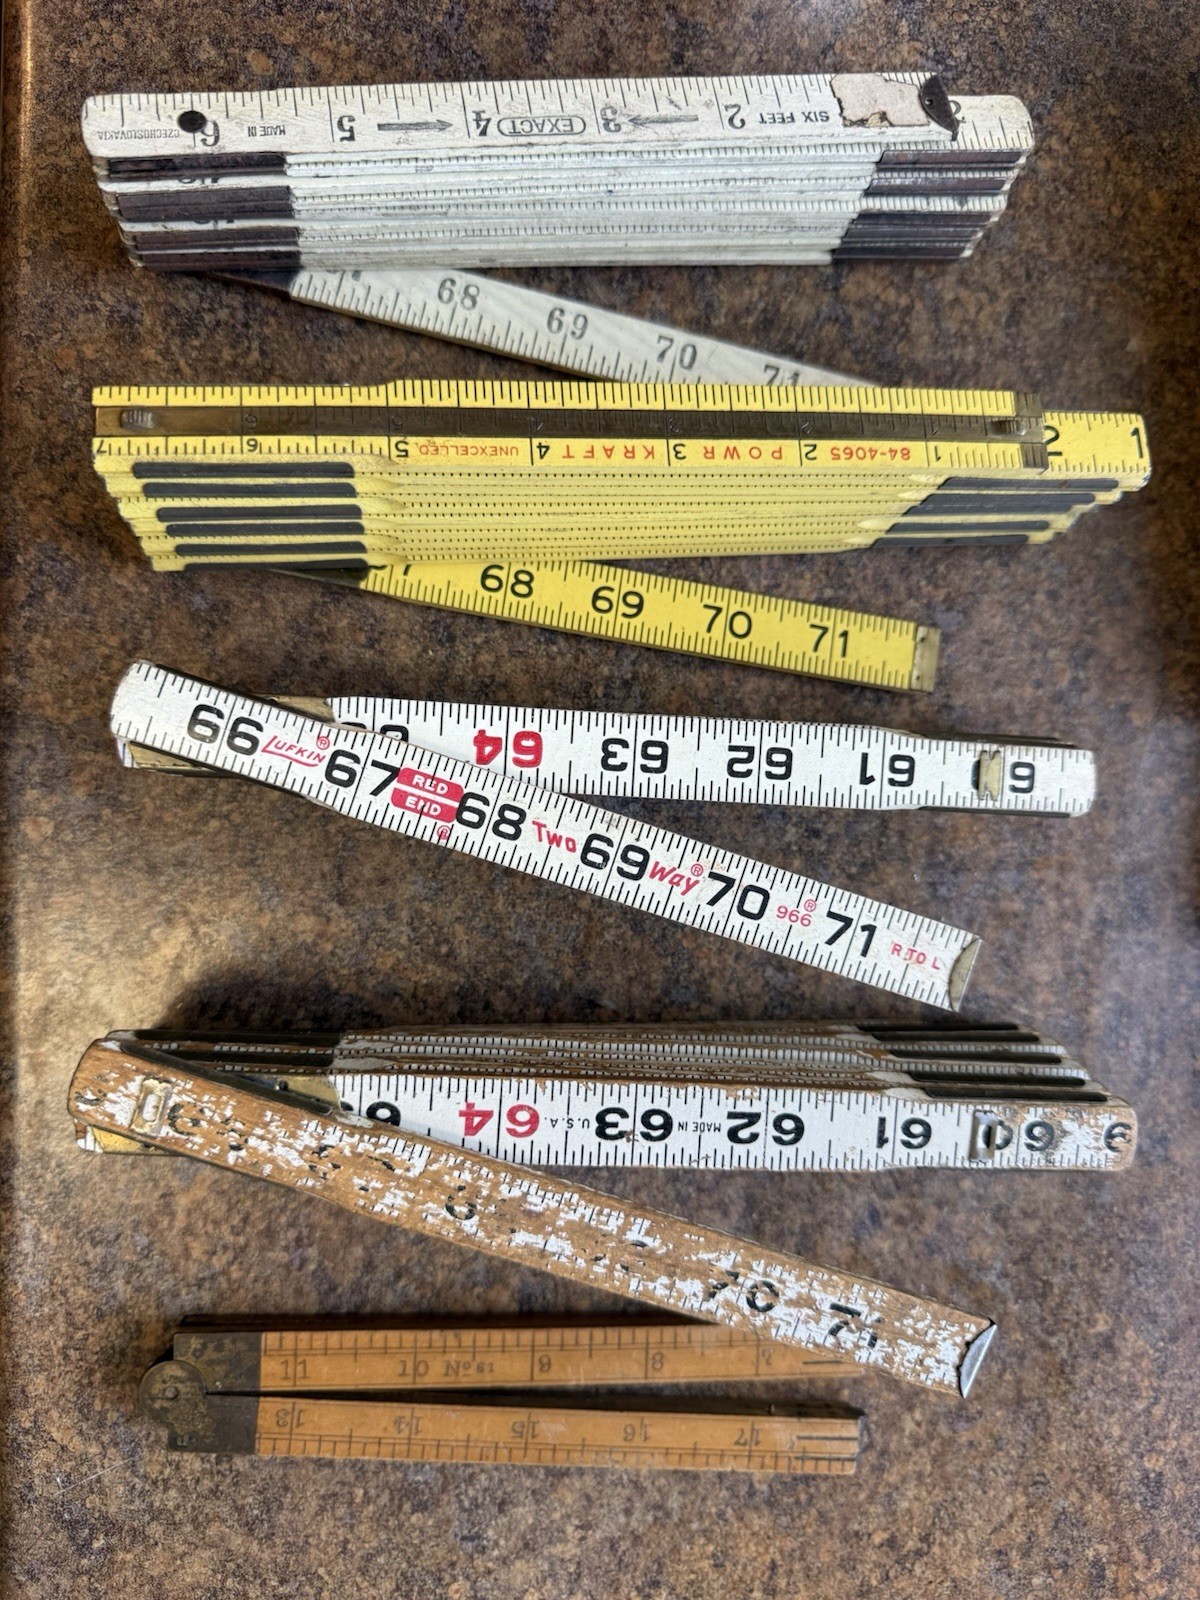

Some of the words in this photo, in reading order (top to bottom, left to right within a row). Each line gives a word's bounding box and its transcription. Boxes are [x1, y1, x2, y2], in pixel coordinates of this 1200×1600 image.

[337, 115, 356, 142] 5
[472, 110, 491, 137] 4
[508, 118, 574, 135] EXACT
[599, 106, 622, 133] 3
[724, 104, 746, 130] 2
[759, 112, 795, 125] FEET
[802, 111, 830, 123] SIX
[97, 128, 180, 141] CZECHOSLOVAKIA
[247, 126, 258, 138] IN
[259, 125, 287, 137] MADE
[437, 277, 481, 311] 68
[546, 307, 589, 340] 69
[656, 335, 698, 371] 70
[246, 438, 258, 453] 6
[395, 440, 409, 458] 5
[536, 442, 550, 460] 4
[562, 444, 655, 460] KRAFT
[672, 443, 687, 460] 3
[703, 445, 783, 461] POWR
[803, 444, 818, 461] 2
[830, 446, 911, 461] 84-4065
[934, 445, 942, 462] 1
[480, 564, 535, 599] 68
[591, 586, 645, 619] 69
[702, 604, 752, 639] 70
[809, 624, 849, 658] 71
[187, 703, 264, 756] 66
[473, 729, 544, 768] 64
[600, 738, 669, 774] 63
[726, 744, 793, 780] 62
[324, 749, 400, 797] 67
[859, 752, 916, 787] 61
[411, 773, 449, 796] RED
[404, 795, 442, 818] END
[455, 791, 527, 842] 68
[580, 832, 651, 882] 69
[648, 861, 701, 897] Way
[705, 871, 771, 921] 70
[775, 904, 812, 928] 966
[824, 910, 877, 958] 71
[890, 941, 903, 956] R
[905, 948, 927, 965] TO
[930, 956, 941, 970] L
[458, 1101, 541, 1139] 64
[594, 1107, 674, 1142] 63
[677, 1120, 689, 1131] IN
[691, 1121, 722, 1133] MADE
[726, 1111, 805, 1146] 62
[875, 1116, 932, 1150] 61
[279, 1359, 309, 1380] 11
[397, 1359, 430, 1377] 10
